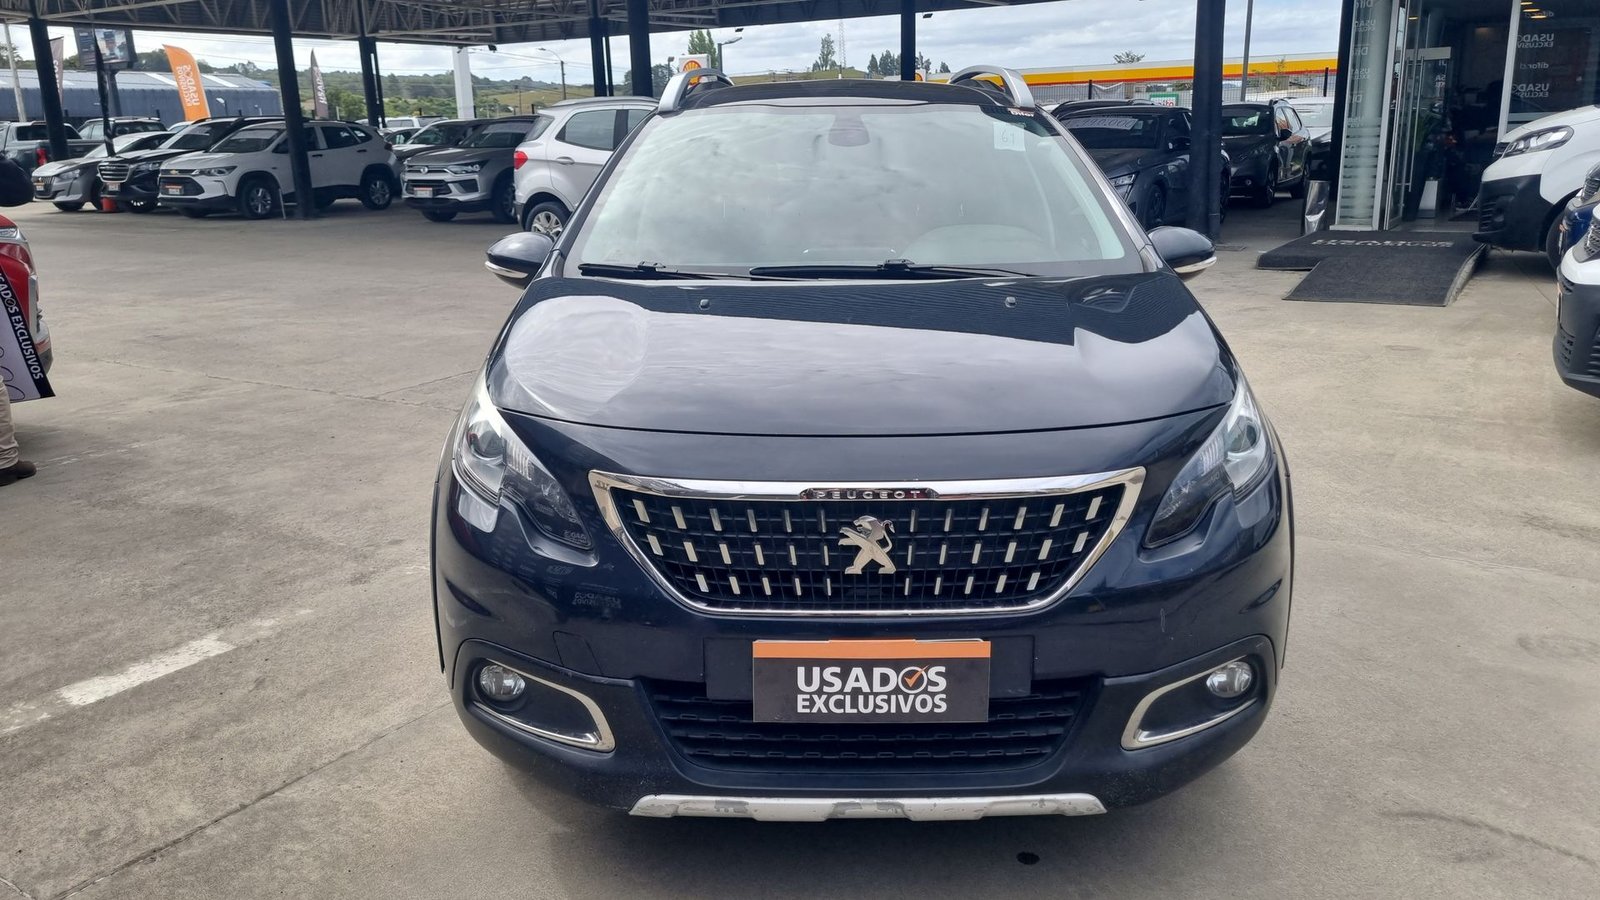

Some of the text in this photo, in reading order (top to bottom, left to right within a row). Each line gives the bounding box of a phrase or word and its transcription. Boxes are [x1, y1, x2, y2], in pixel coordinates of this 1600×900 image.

[12, 315, 44, 379] EXCLUSIVOS
[816, 490, 920, 499] PEUGEOT
[797, 666, 947, 694] USADOS
[797, 694, 947, 714] EXCLUSIVOS
